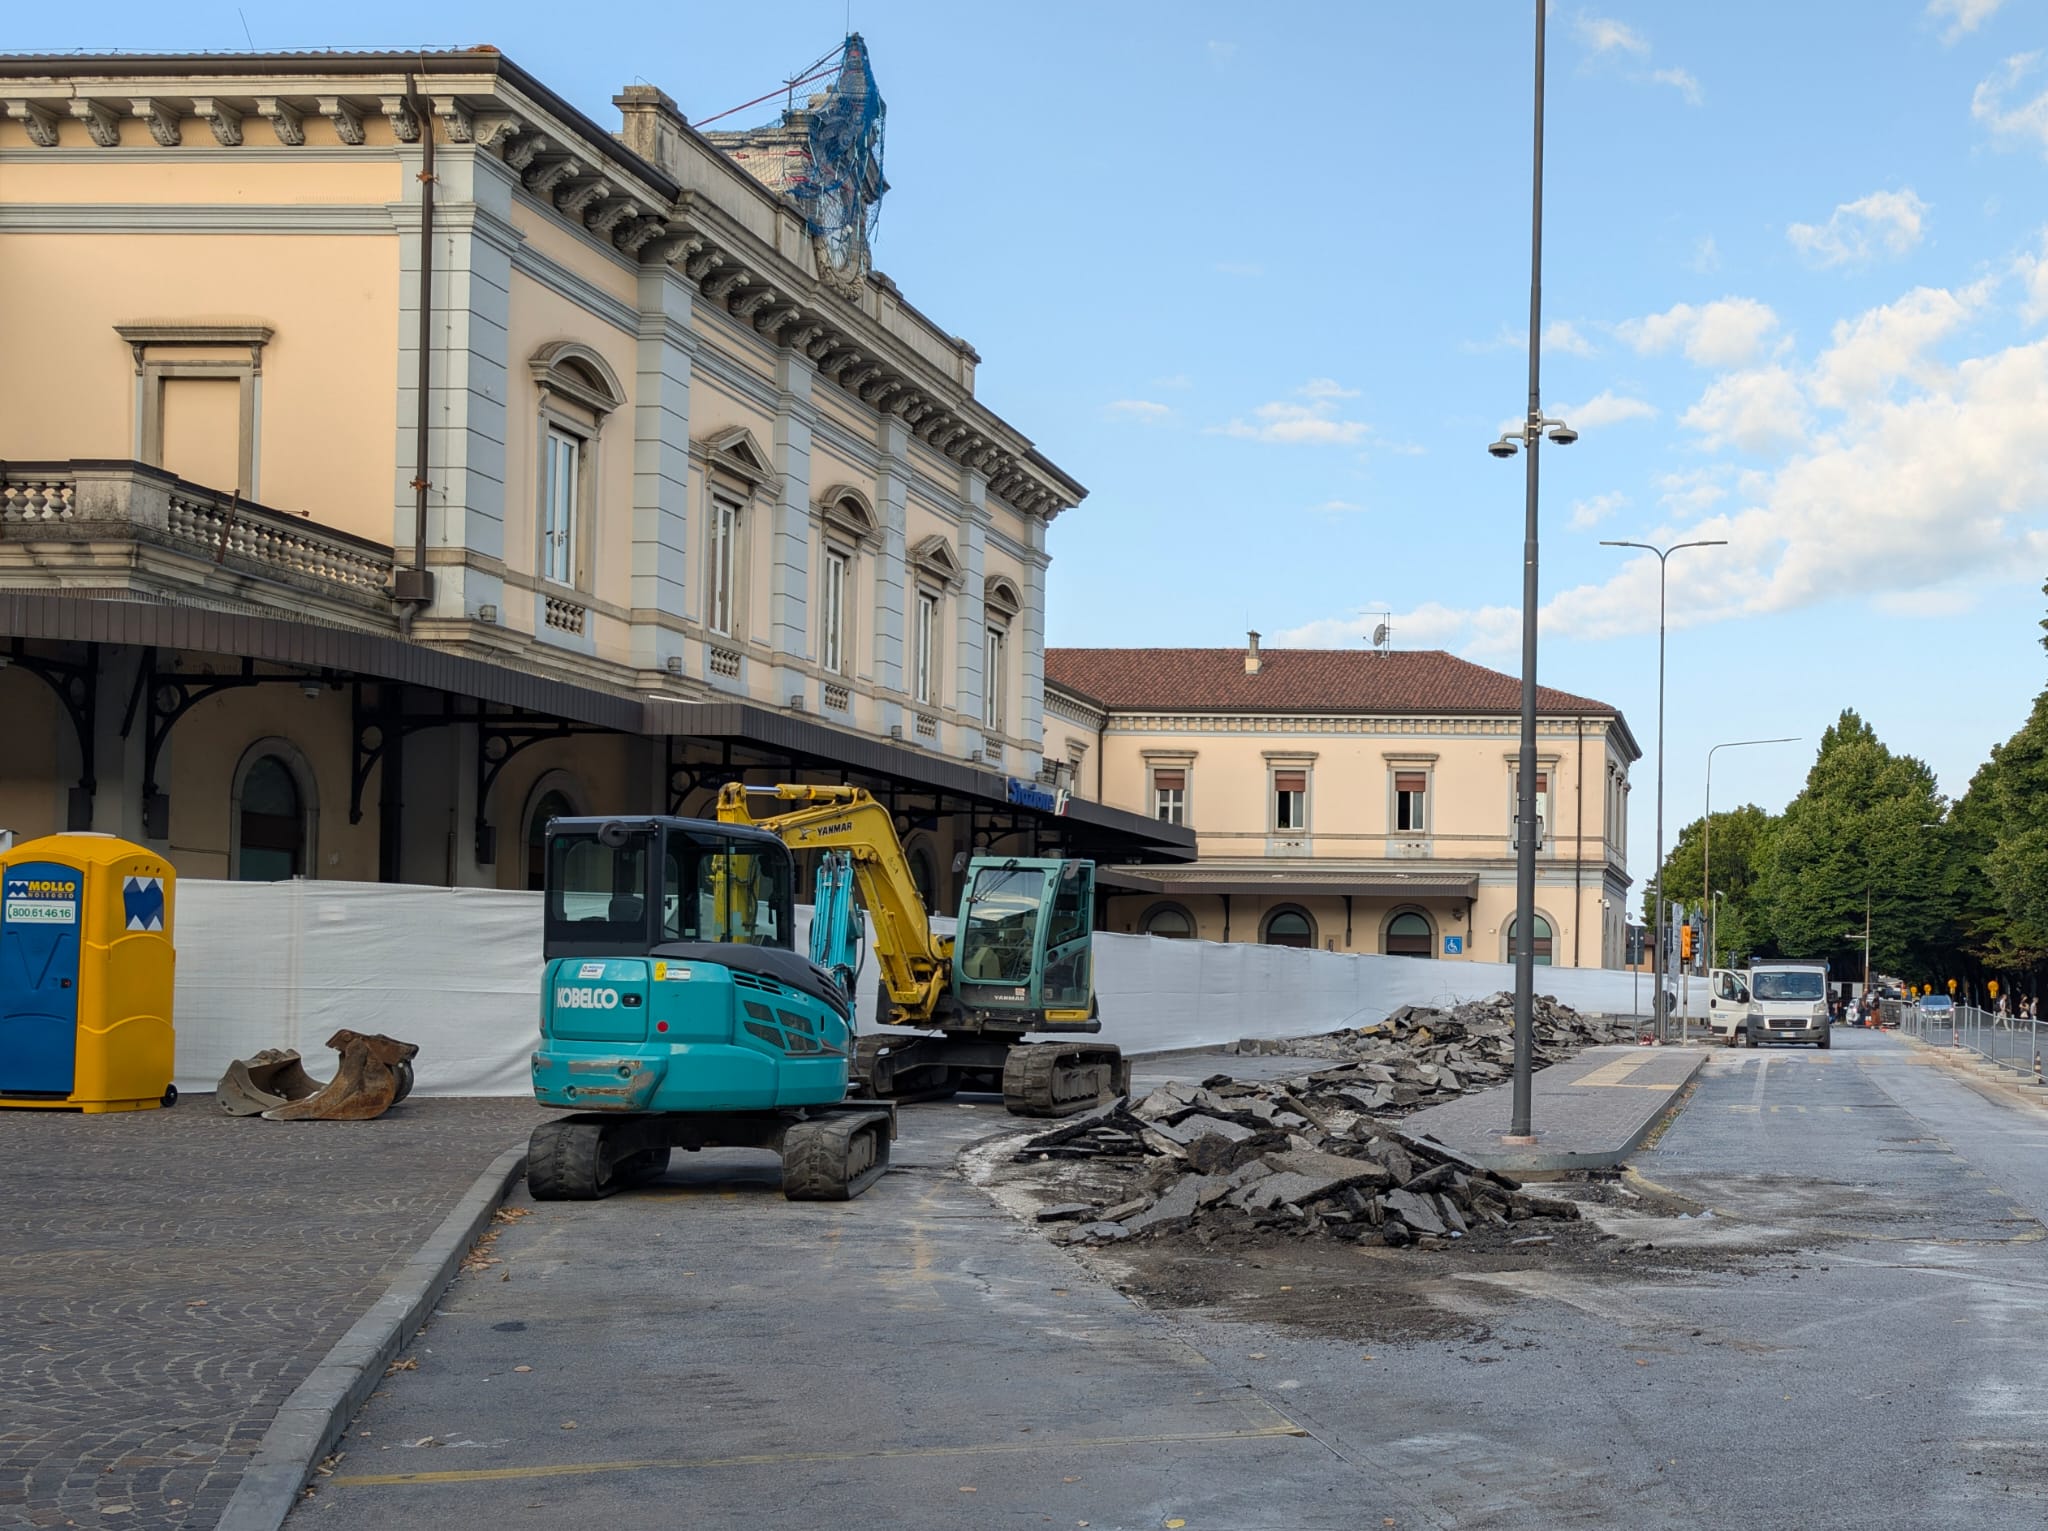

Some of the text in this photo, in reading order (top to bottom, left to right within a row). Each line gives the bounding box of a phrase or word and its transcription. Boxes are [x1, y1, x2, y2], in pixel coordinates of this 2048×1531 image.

[817, 822, 852, 836] YANMAR
[28, 881, 75, 892] MOLLO
[557, 987, 619, 1009] KOBELCO
